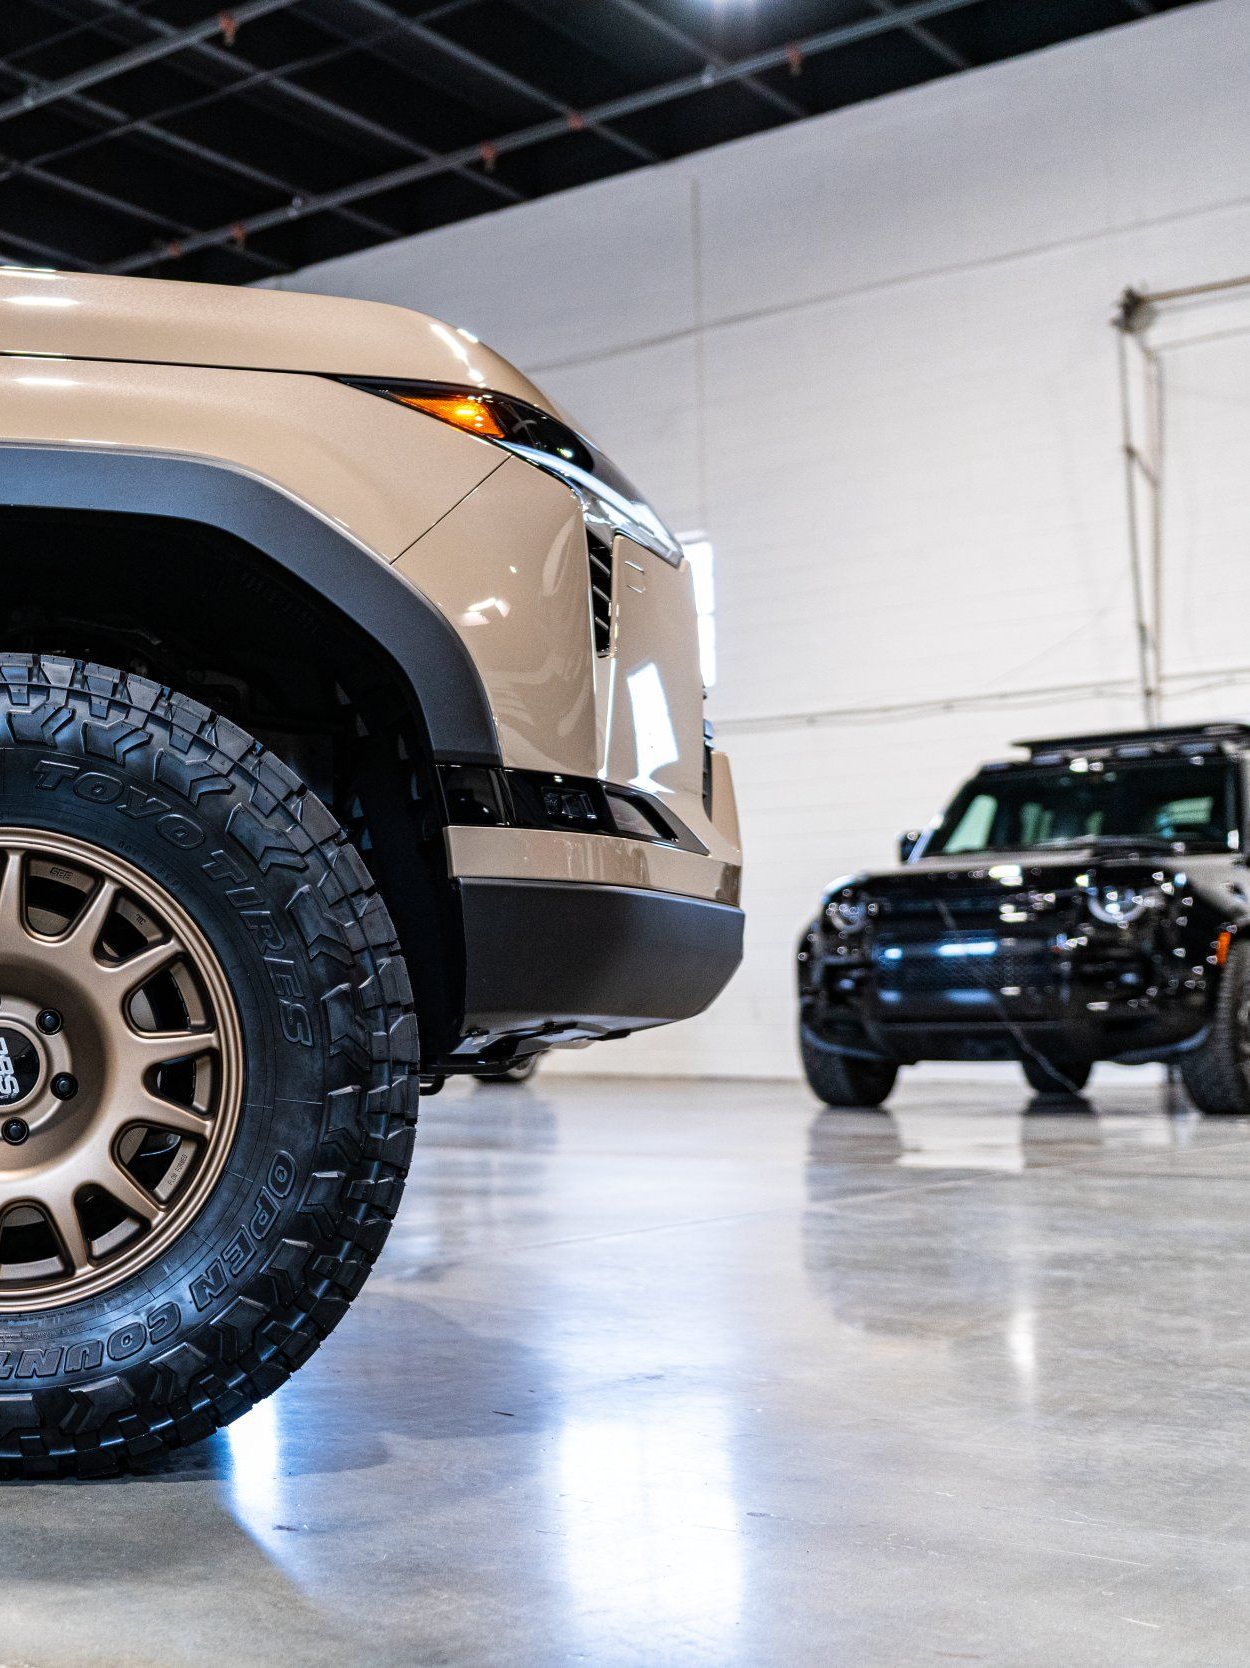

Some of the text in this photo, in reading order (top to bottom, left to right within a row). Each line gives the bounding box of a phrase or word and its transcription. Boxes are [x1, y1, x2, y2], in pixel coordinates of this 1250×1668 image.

[35, 760, 314, 1047] TOYO TIRES
[190, 1150, 297, 1312] OPEN
